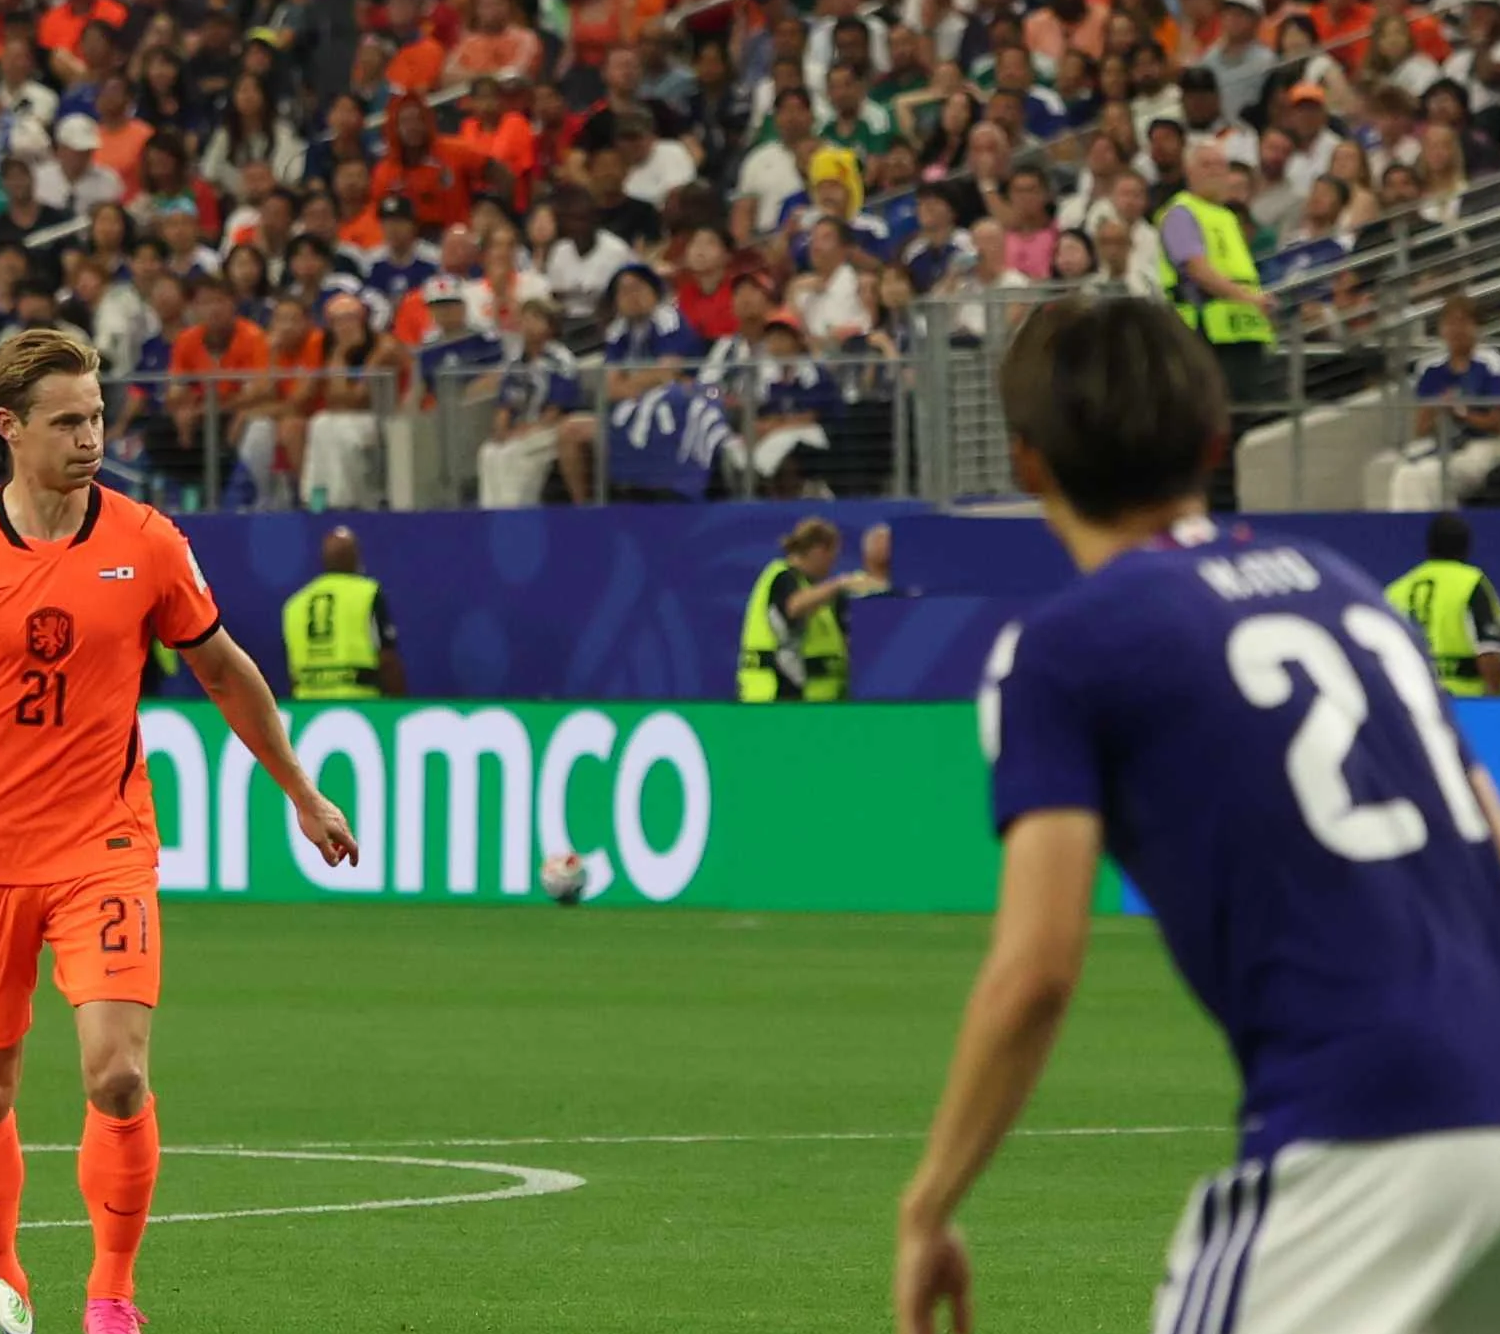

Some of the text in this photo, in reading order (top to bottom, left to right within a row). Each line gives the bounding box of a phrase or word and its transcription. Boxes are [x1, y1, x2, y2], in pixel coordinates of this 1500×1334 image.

[16, 668, 67, 728] 21
[1226, 603, 1491, 863] 21
[100, 896, 147, 955] 21
